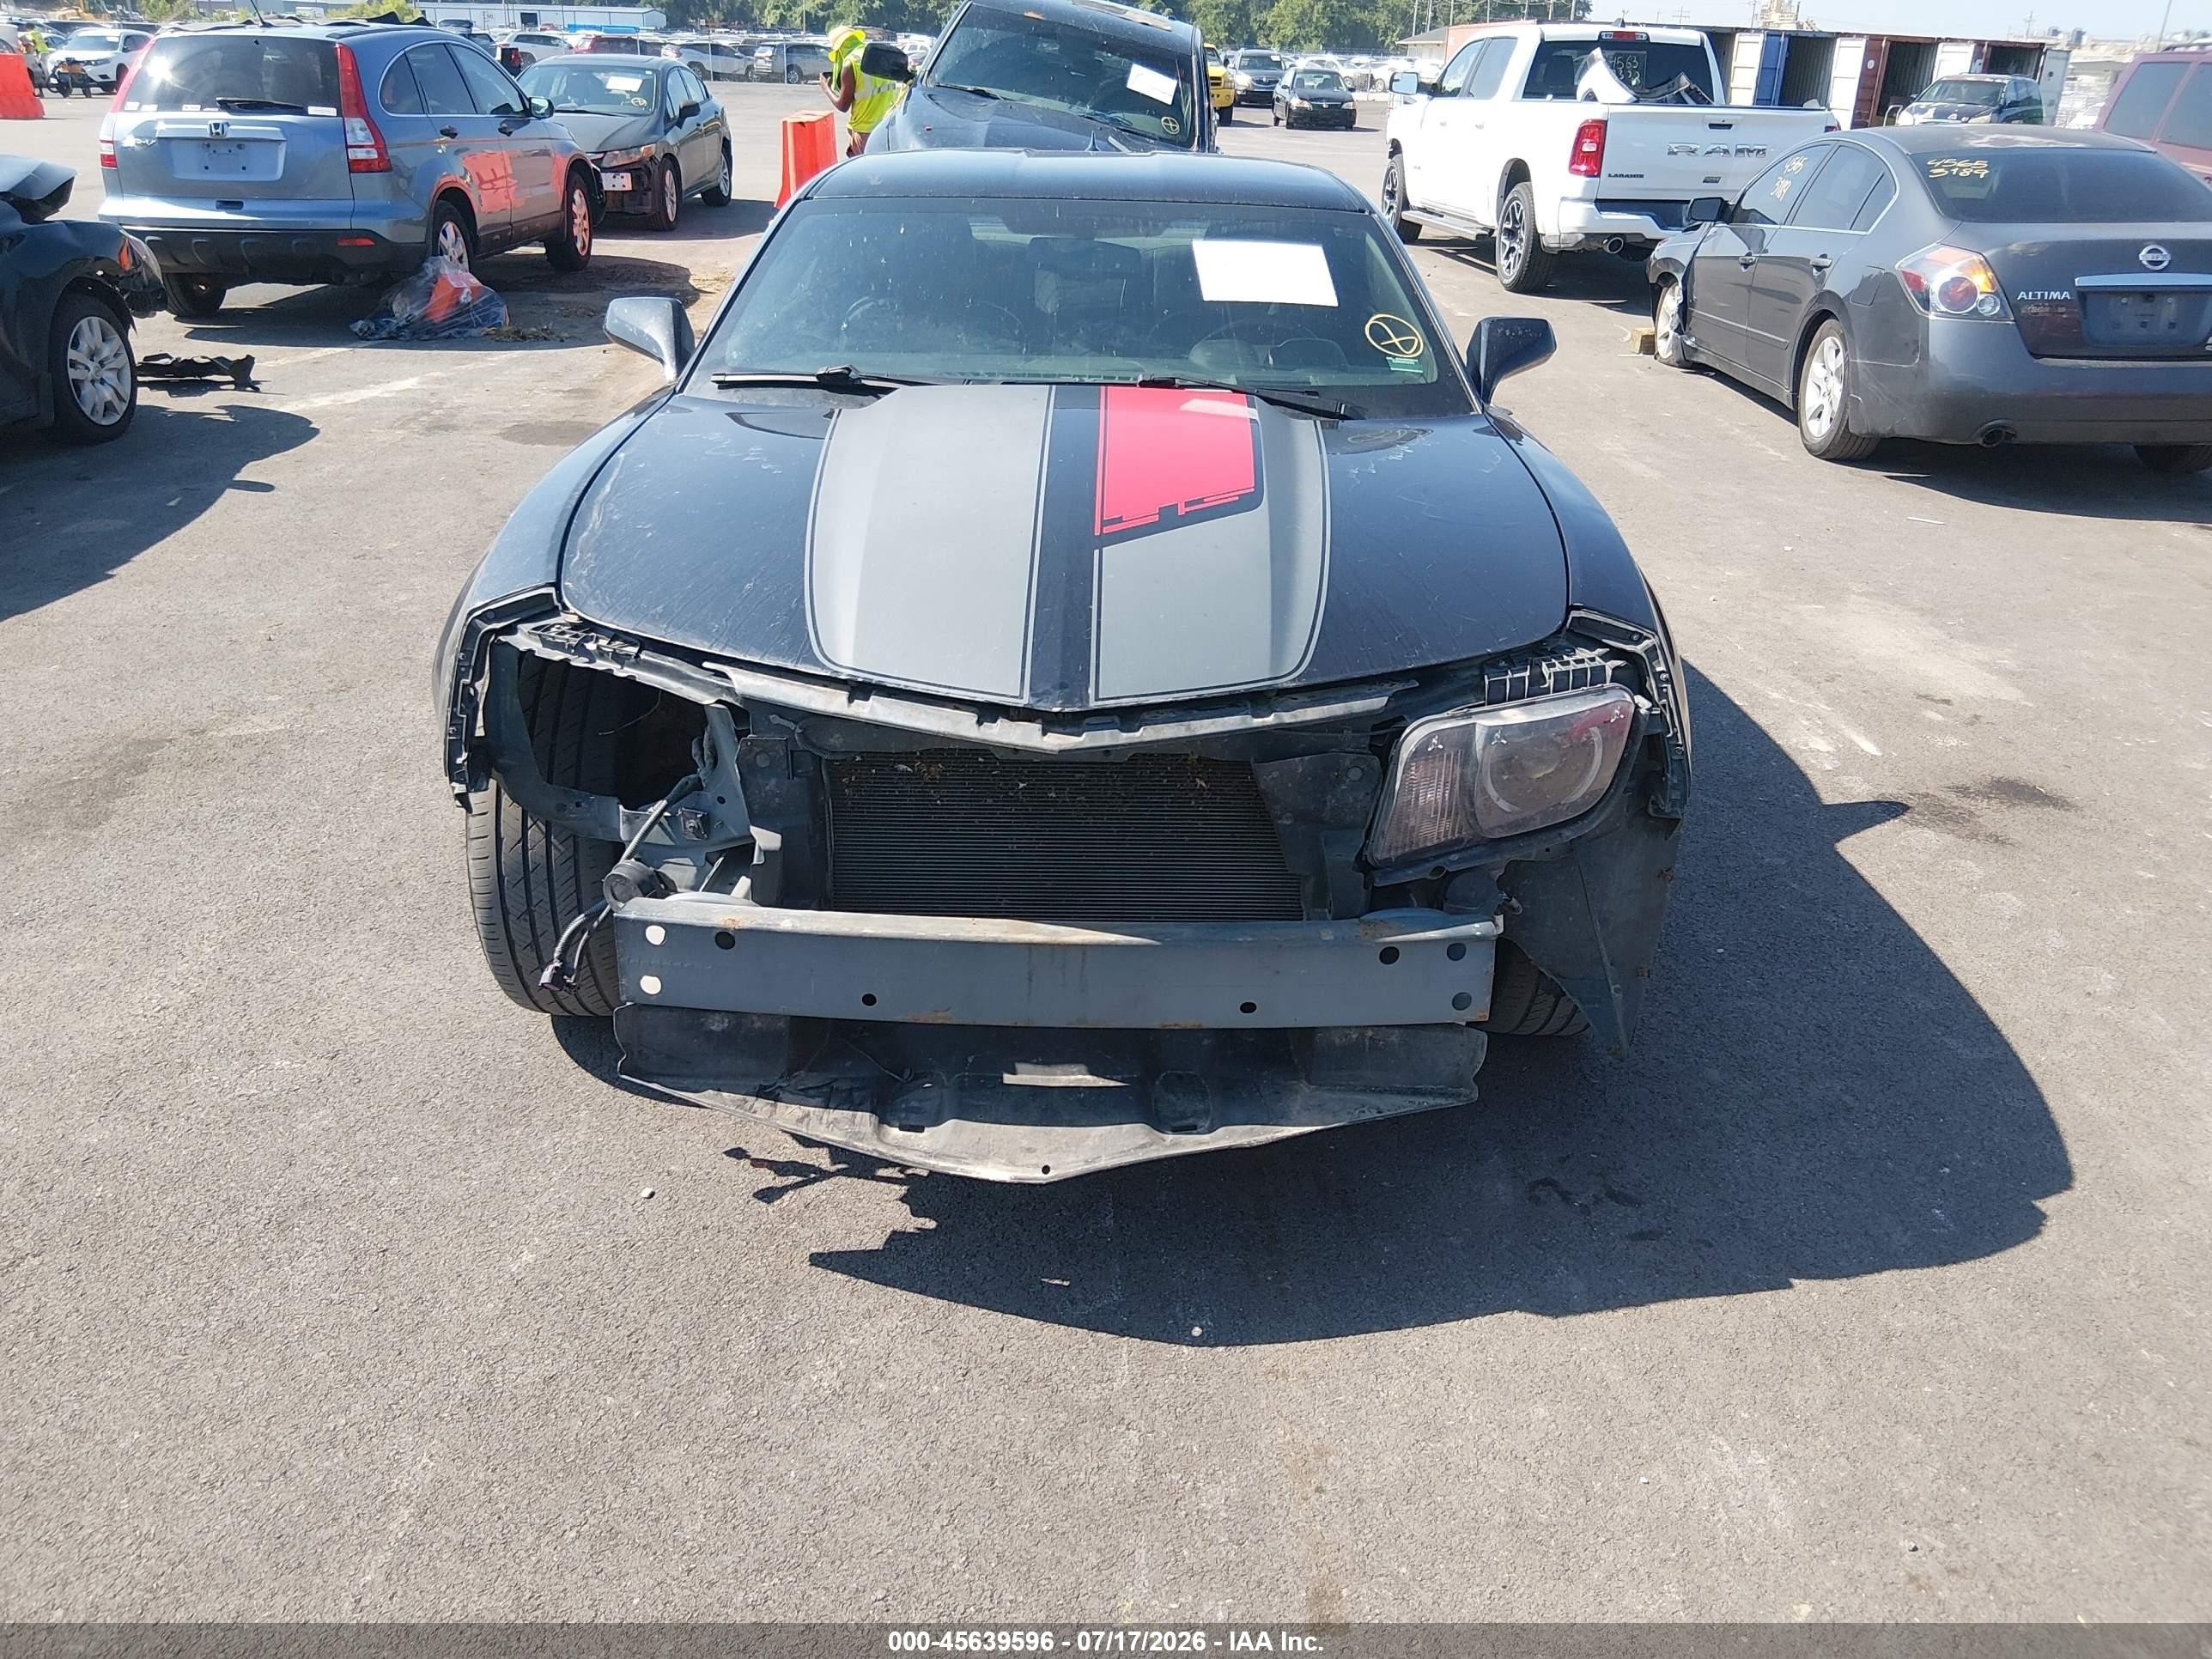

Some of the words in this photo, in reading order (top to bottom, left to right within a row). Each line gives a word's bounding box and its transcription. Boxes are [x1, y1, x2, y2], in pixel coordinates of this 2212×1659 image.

[1667, 142, 1767, 158] RAM
[1926, 158, 1989, 169] 4565
[1929, 167, 1990, 179] 3189
[2016, 290, 2071, 301] ALTIMA
